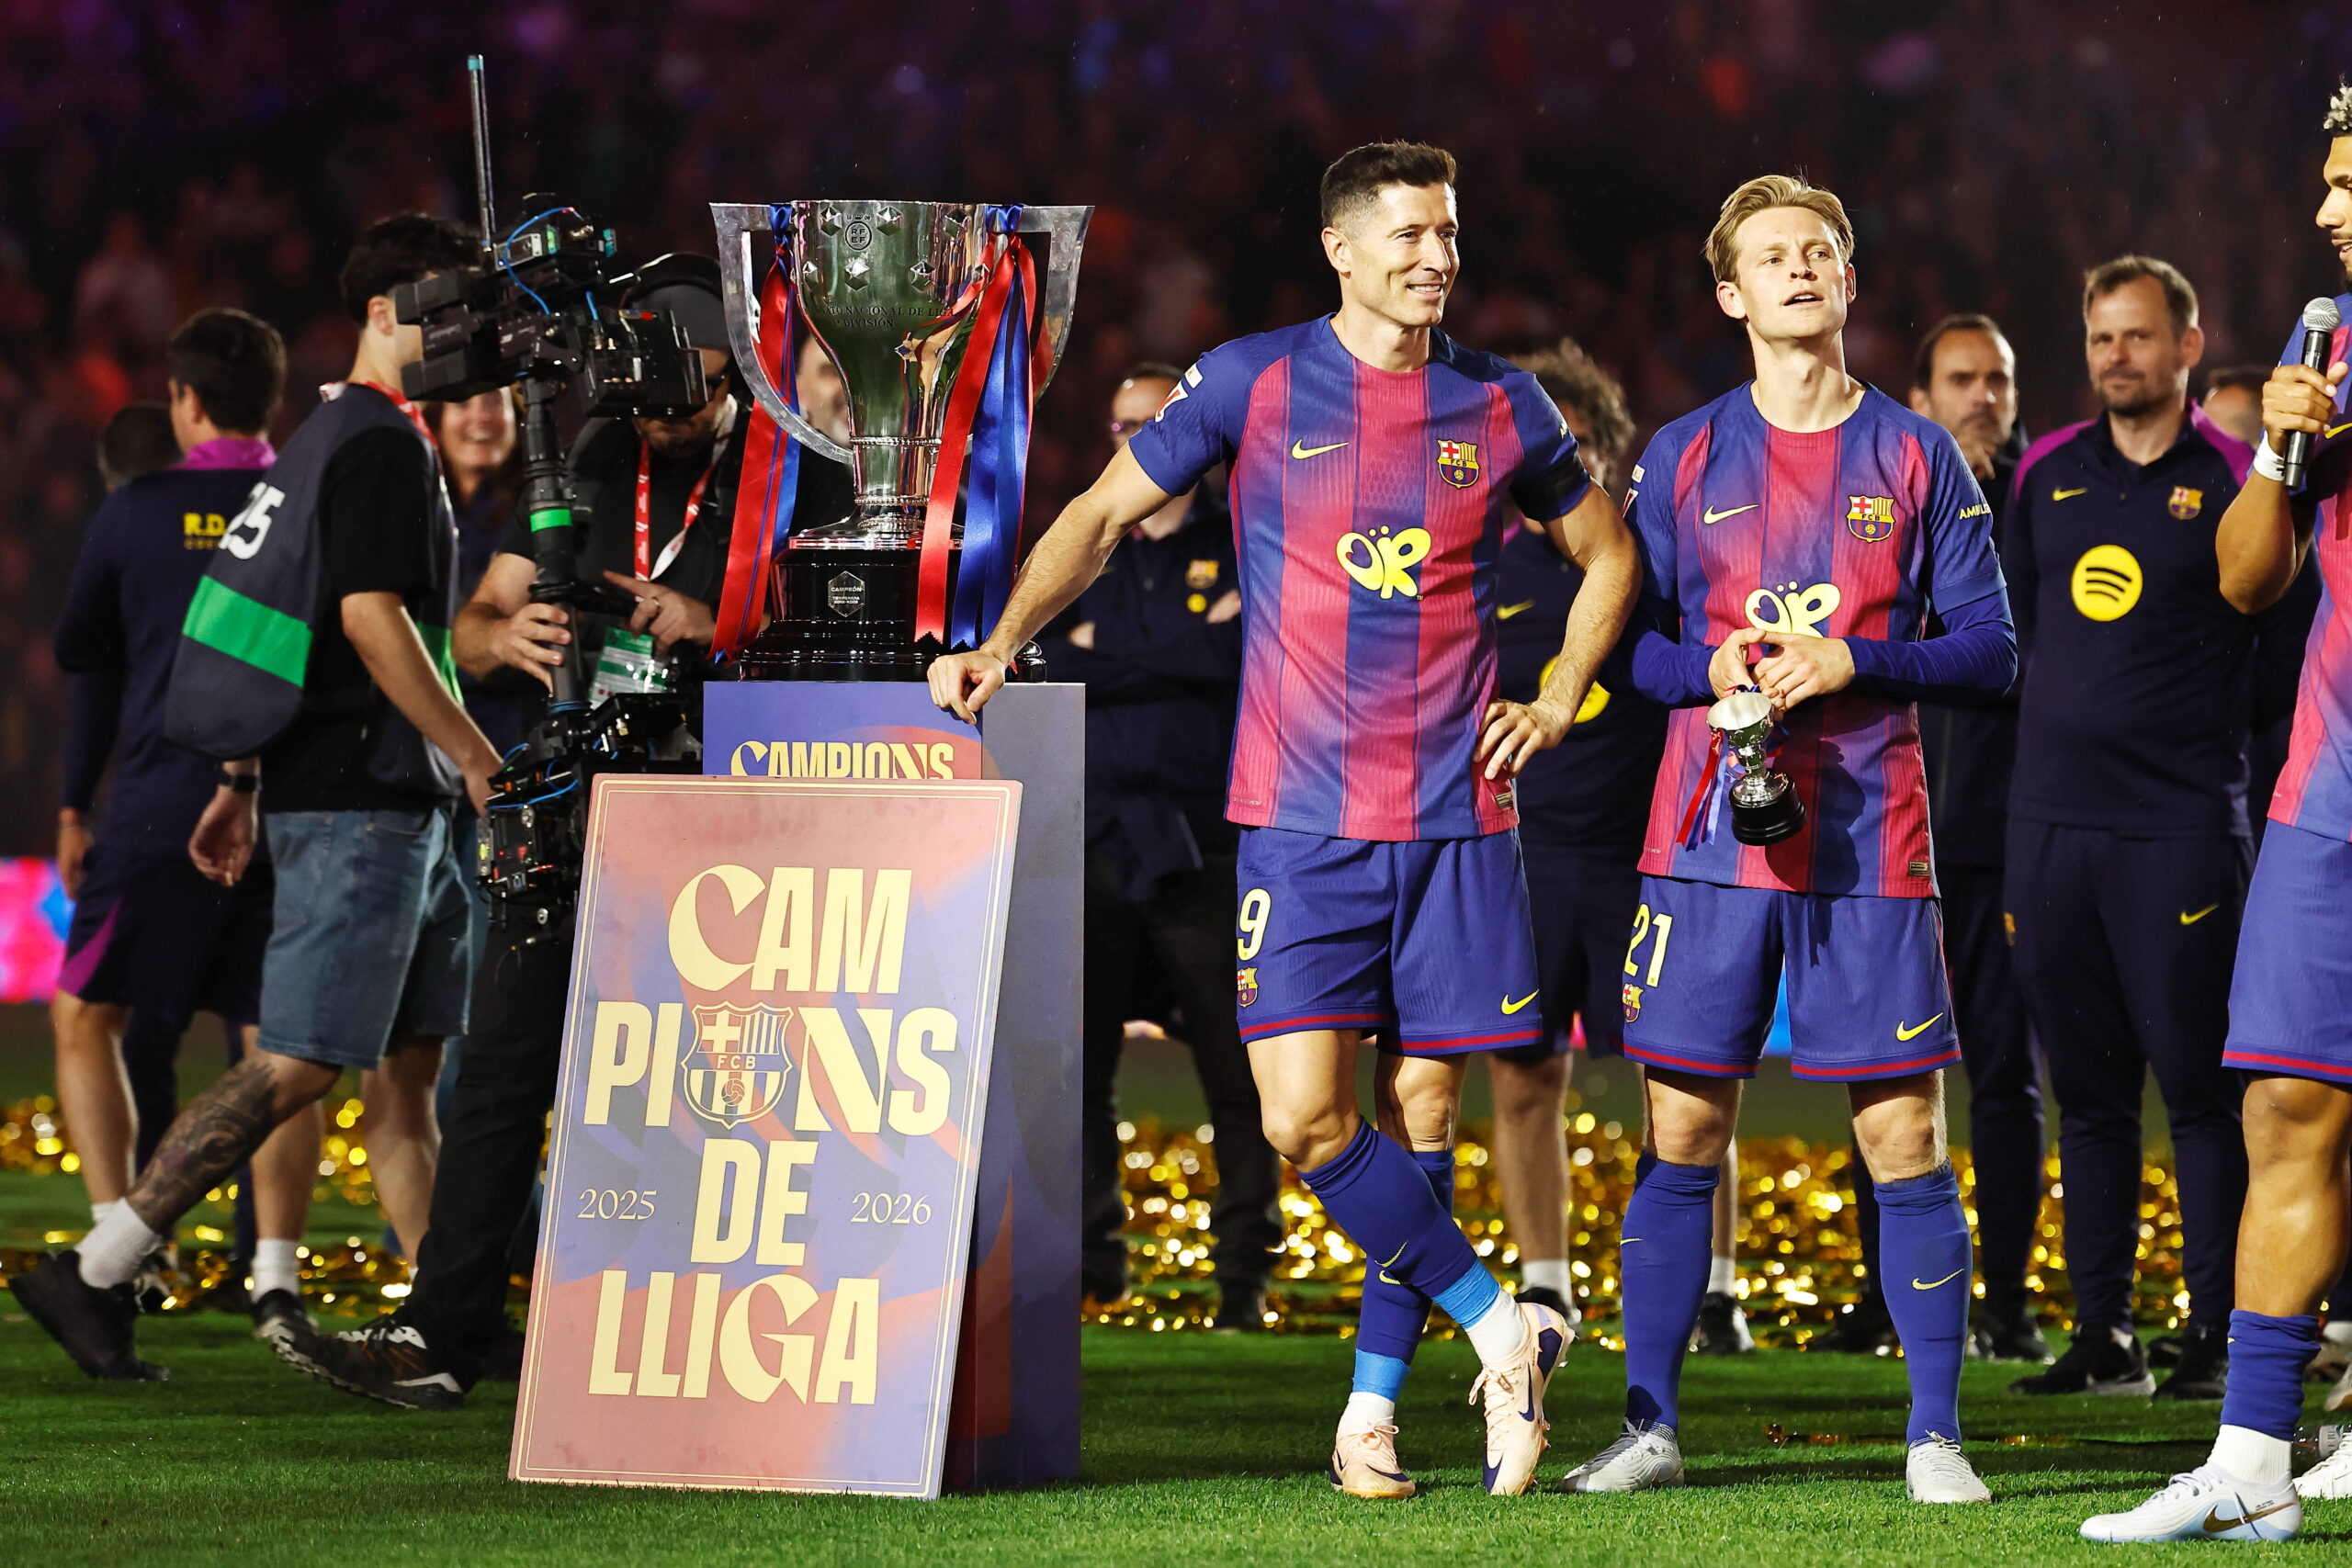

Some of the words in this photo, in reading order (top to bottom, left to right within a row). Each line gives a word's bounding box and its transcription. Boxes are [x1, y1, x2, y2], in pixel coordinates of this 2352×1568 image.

[908, 307, 924, 317] DE
[1450, 458, 1467, 468] FCB
[1861, 513, 1881, 522] FCB
[730, 740, 955, 780] CAMPIONS
[667, 863, 913, 994] CAM
[1237, 887, 1272, 962] 9
[1623, 903, 1673, 988] 21
[717, 1055, 756, 1070] FCB
[577, 1189, 658, 1222] 2025
[690, 1138, 820, 1267] DE
[850, 1191, 933, 1225] 2026
[587, 1269, 880, 1406] LLIGA
